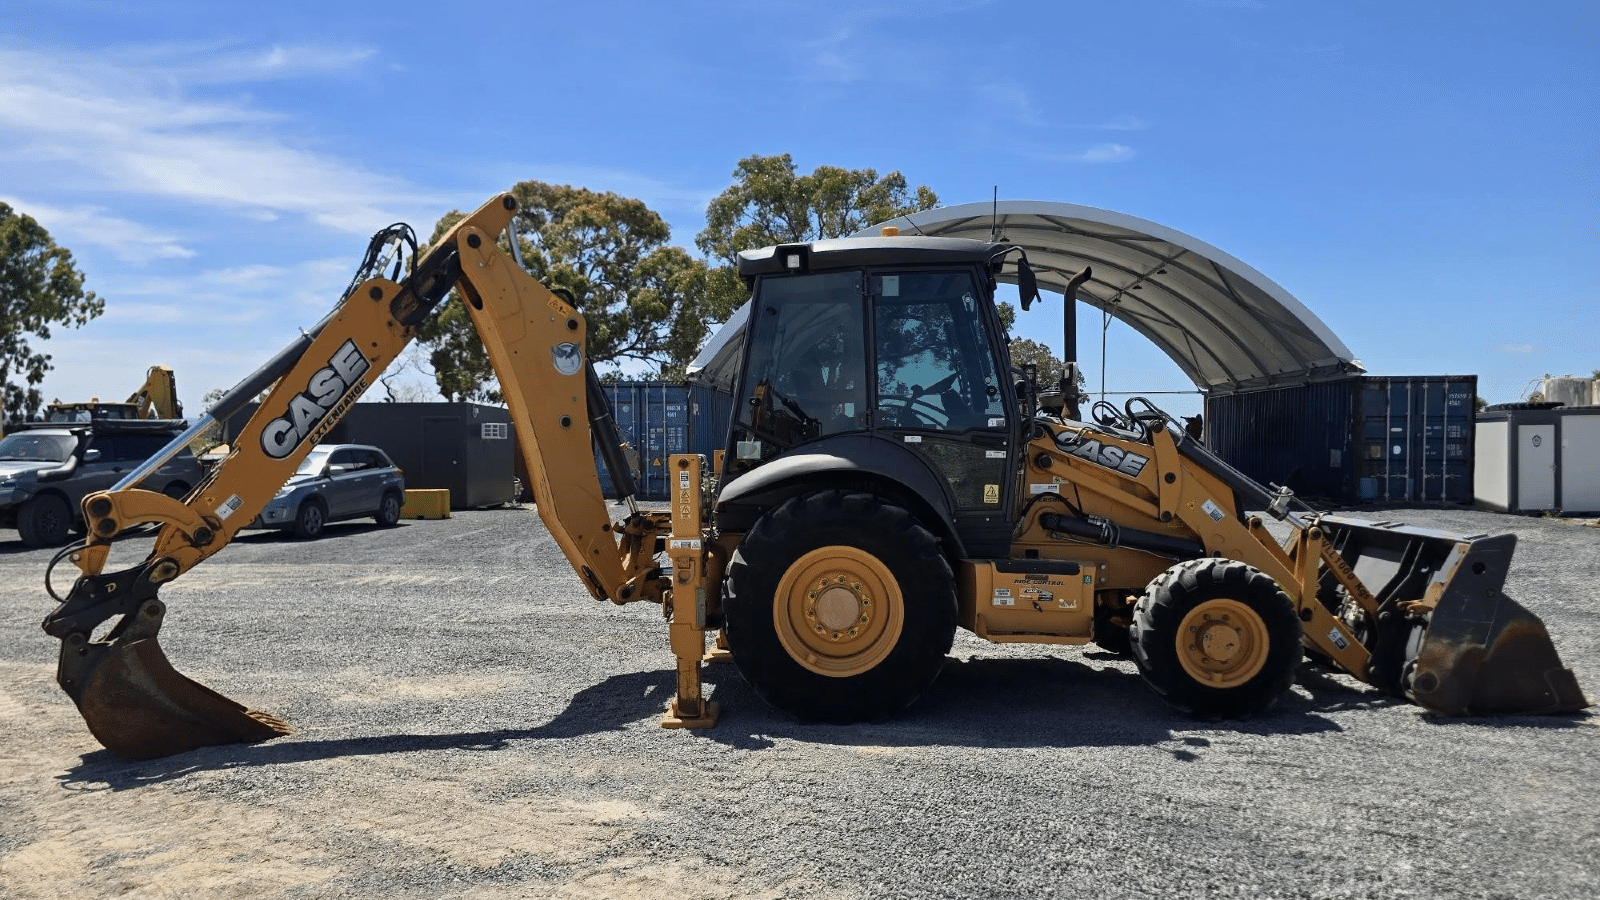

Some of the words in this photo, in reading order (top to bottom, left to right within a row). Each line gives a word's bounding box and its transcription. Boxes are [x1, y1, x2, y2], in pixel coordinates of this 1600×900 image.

[261, 338, 370, 459] CASE
[309, 378, 369, 446] EXTENDAHOE
[1053, 429, 1150, 478] CASE
[1321, 537, 1336, 558] WLL
[1334, 557, 1355, 580] 1000
